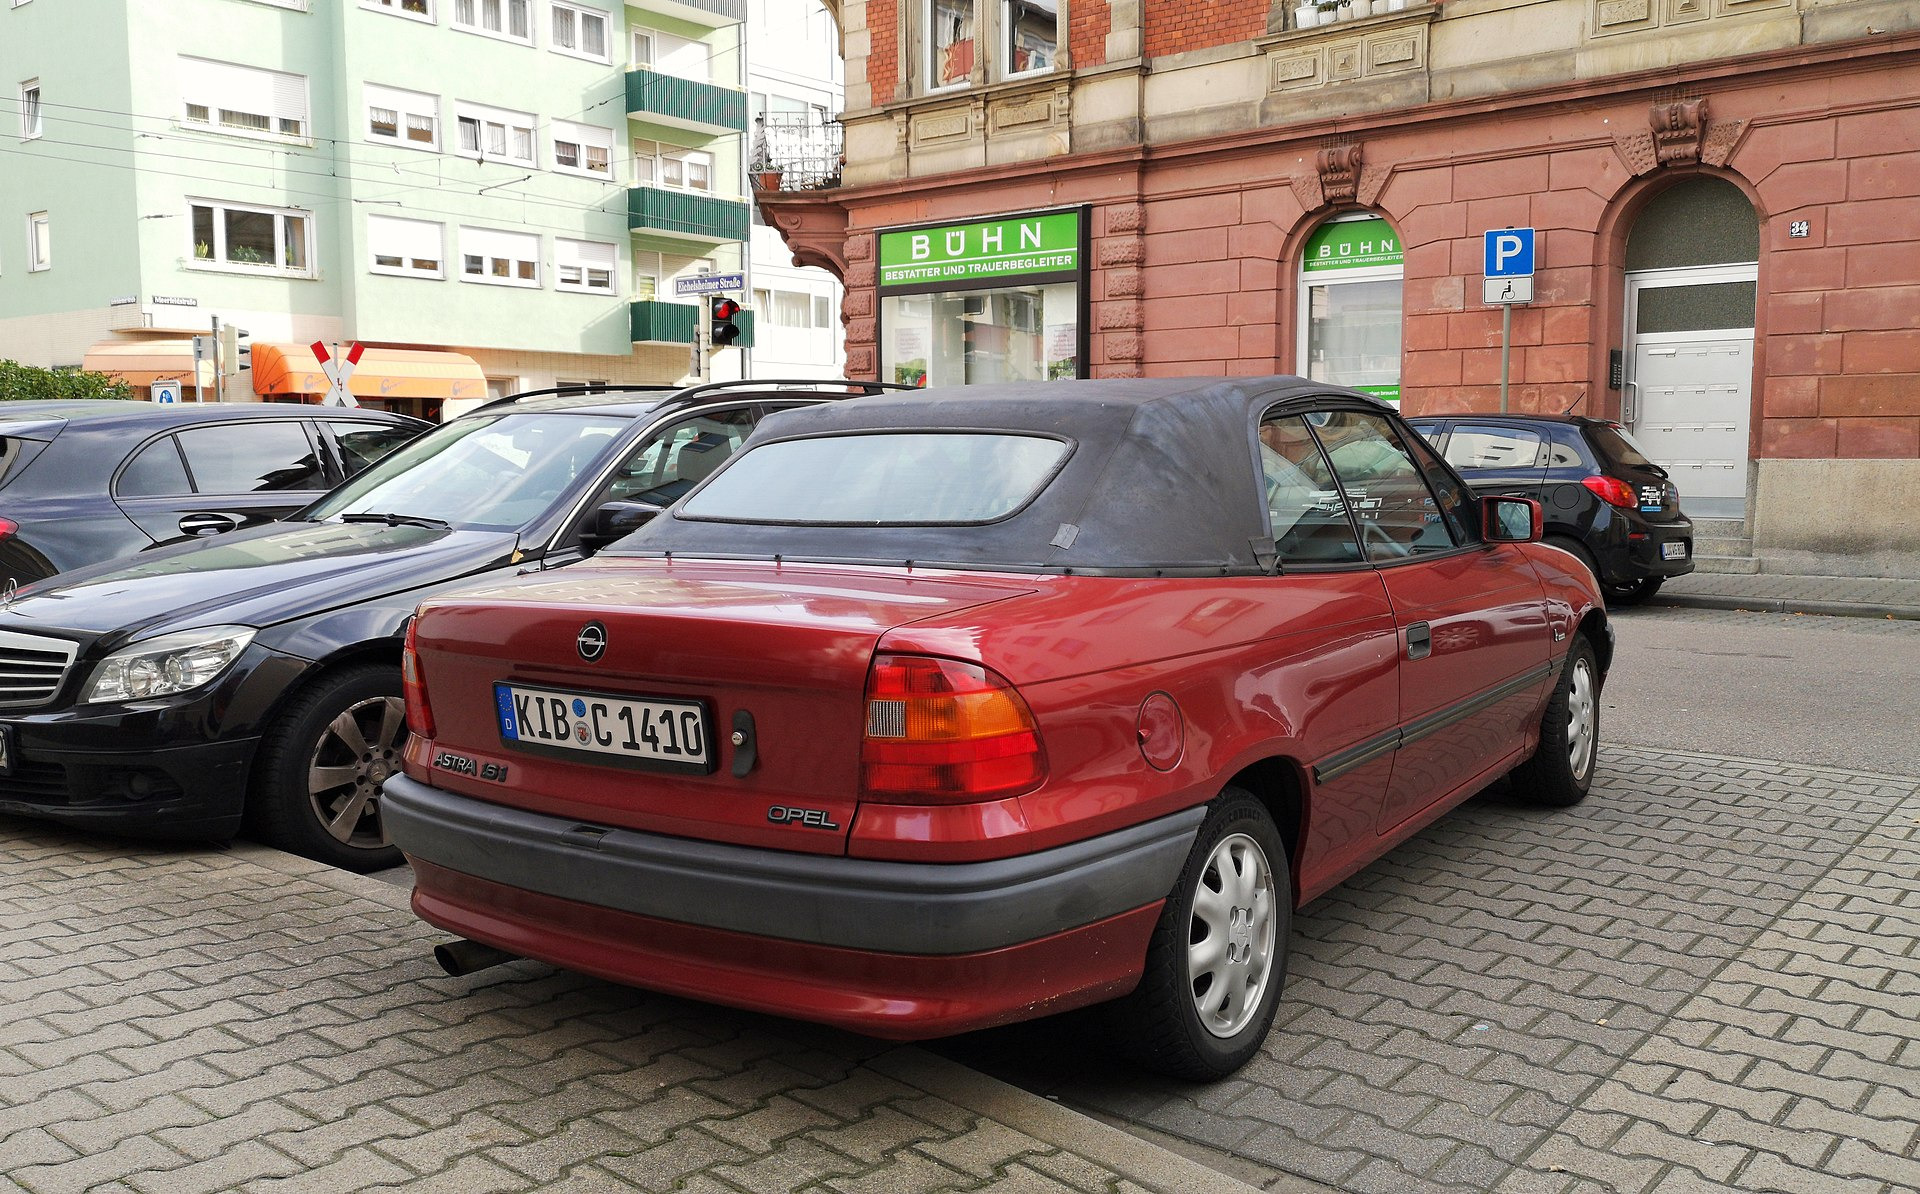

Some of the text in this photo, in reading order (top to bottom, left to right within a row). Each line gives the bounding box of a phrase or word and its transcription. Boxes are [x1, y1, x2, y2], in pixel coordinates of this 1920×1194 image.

[1791, 221, 1808, 233] 34
[911, 222, 1041, 260] BÜHN
[1319, 239, 1394, 257] BÜHN
[1496, 235, 1522, 271] P
[885, 255, 1072, 281] BESTATTER UND TRAUERBEGLEITER
[1309, 259, 1339, 267] BESTATTER
[1352, 255, 1403, 264] TRAUERBEGLEITER
[677, 276, 740, 292] Eichelsheimer Straße
[505, 718, 512, 730] D
[514, 694, 703, 756] KIB C 1410
[433, 752, 477, 776] ASTRA
[767, 805, 839, 830] OPEL
